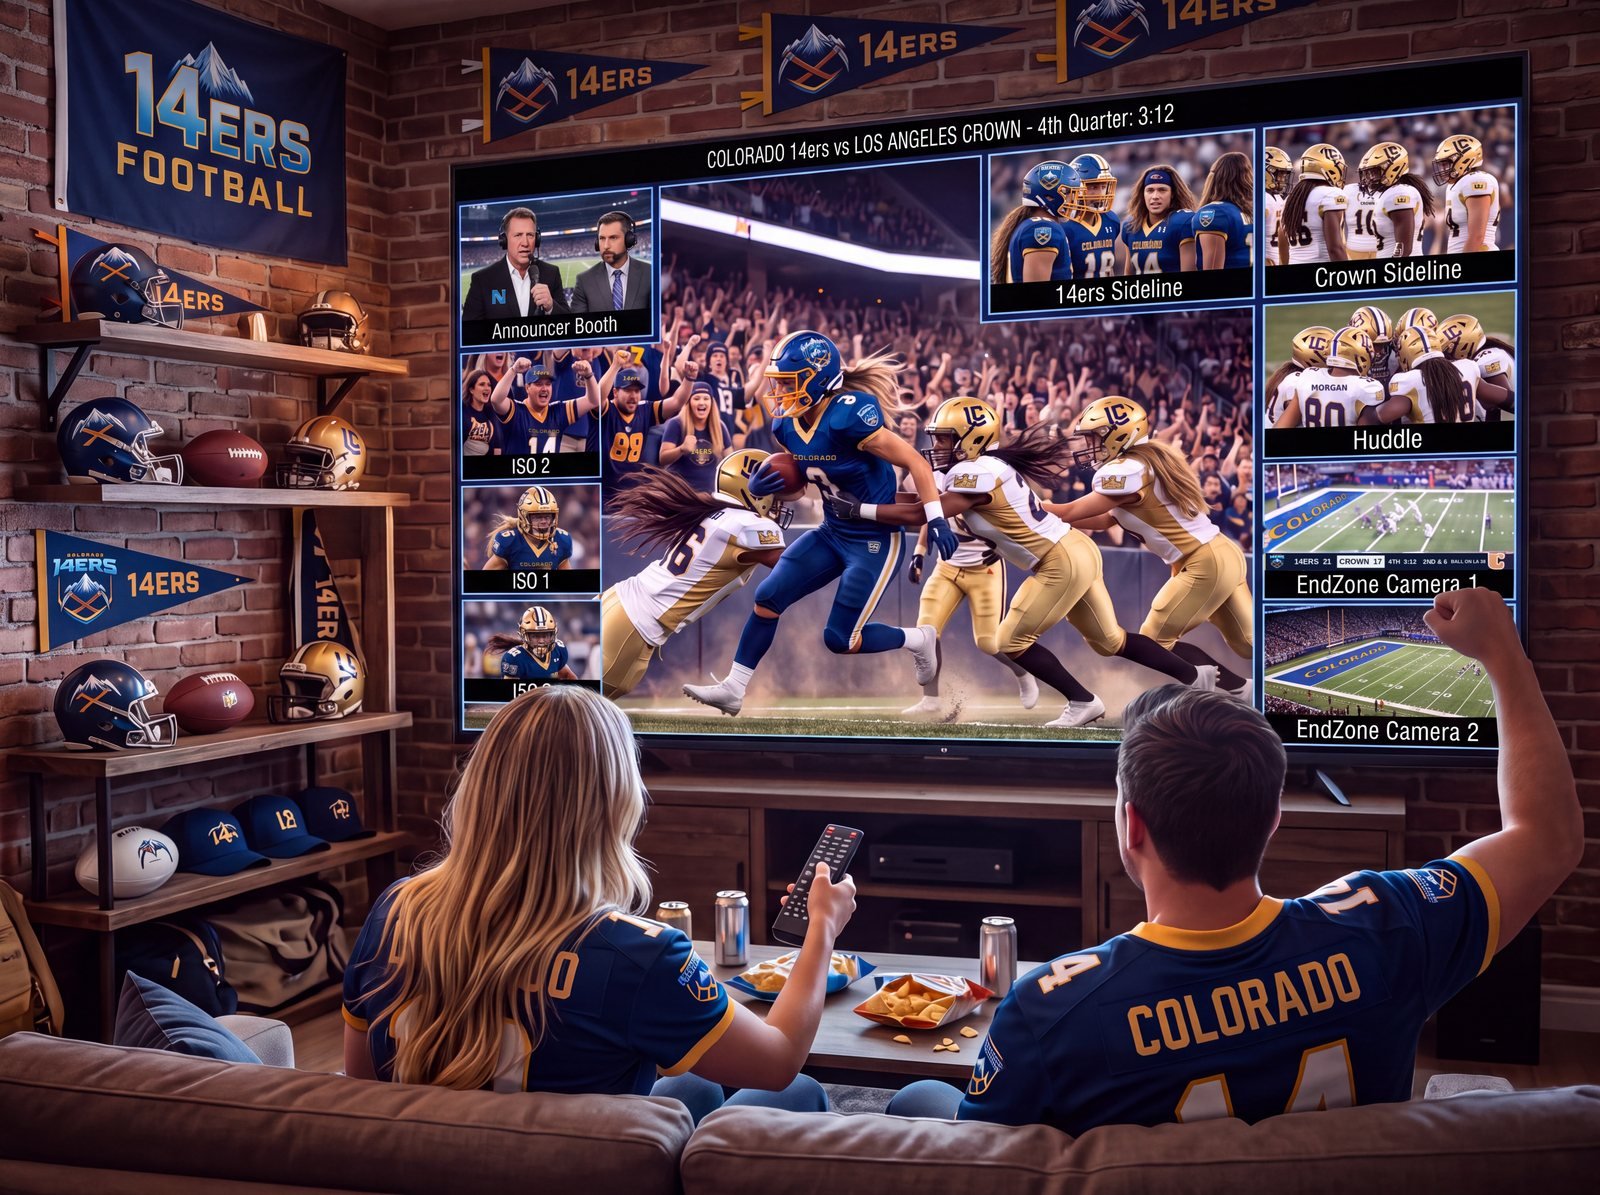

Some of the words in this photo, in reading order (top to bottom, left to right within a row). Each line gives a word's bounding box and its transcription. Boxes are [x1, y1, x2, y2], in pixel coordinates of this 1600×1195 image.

[858, 30, 958, 68] 14ERS
[566, 65, 653, 100] 14ERS
[124, 51, 312, 175] 14ERS
[707, 143, 785, 169] COLORADO
[790, 141, 830, 161] 14ers
[834, 140, 850, 156] vs
[855, 133, 883, 154] LOS
[887, 125, 957, 151] ANGELES
[962, 119, 1021, 142] CROWN
[1037, 116, 1062, 136] 4th
[1068, 110, 1133, 133] Quarter:
[1138, 103, 1175, 126] 3:12
[117, 141, 313, 218] FOOTBALL
[1315, 267, 1377, 288] Crown
[1384, 260, 1462, 284] Sideline
[1055, 283, 1105, 304] 14ers
[1111, 279, 1183, 301] Sideline
[491, 321, 570, 340] Announcer
[575, 315, 618, 334] Booth
[1311, 384, 1348, 392] MORGAN
[1353, 428, 1423, 450] Huddle
[512, 458, 537, 475] ISO
[541, 457, 550, 474] 2
[1268, 492, 1348, 540] COLORADO
[53, 558, 118, 577] 14ERS
[512, 571, 538, 590] ISO
[542, 572, 549, 590] 1
[127, 571, 200, 598] 14ERS
[1297, 574, 1379, 595] EndZone
[1386, 573, 1460, 594] Camera
[1468, 573, 1478, 589] 1
[1304, 645, 1387, 678] COLORADO
[1297, 719, 1379, 740] EndZone
[1386, 720, 1460, 742] Camera
[1467, 722, 1479, 742] 2
[1127, 952, 1362, 1057] COLORADO
